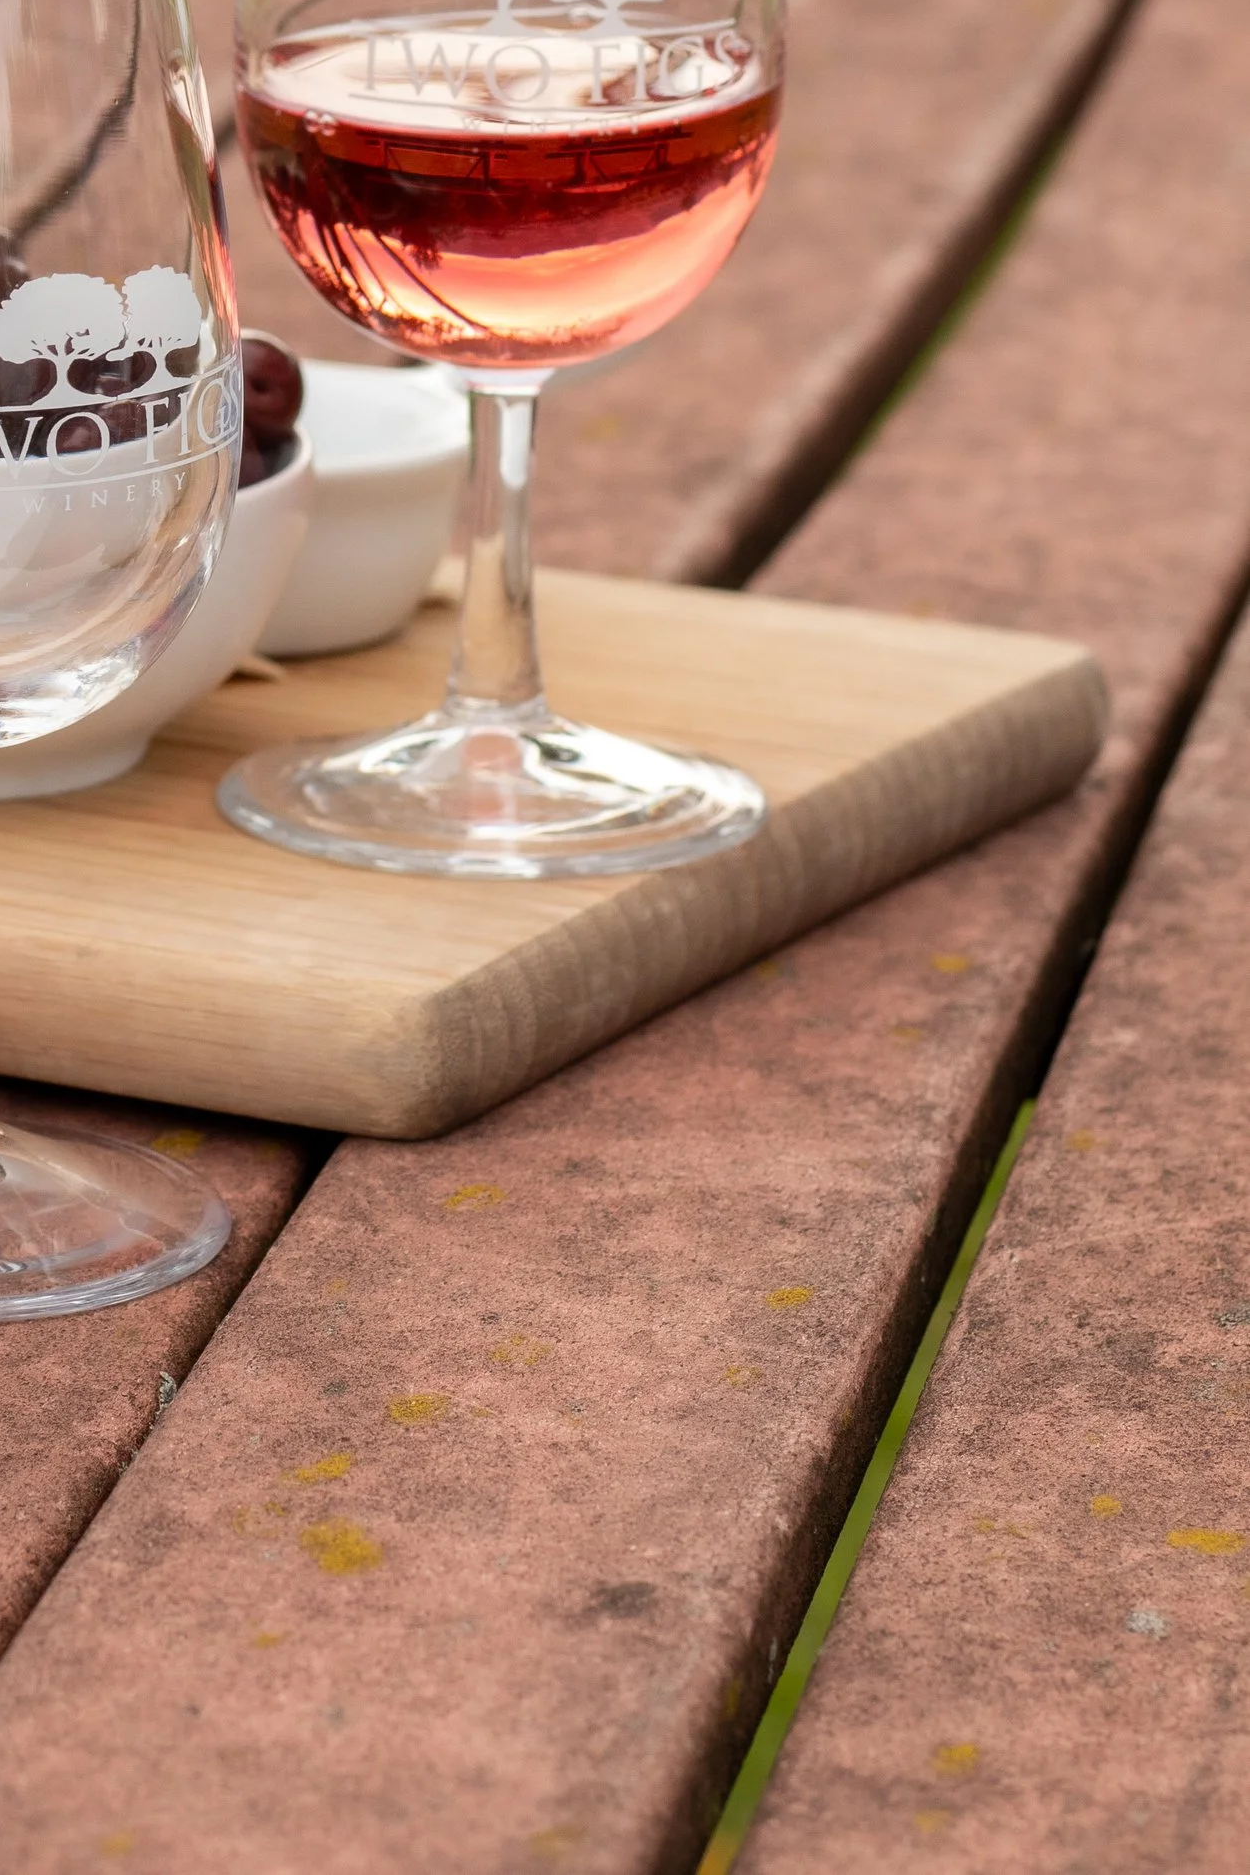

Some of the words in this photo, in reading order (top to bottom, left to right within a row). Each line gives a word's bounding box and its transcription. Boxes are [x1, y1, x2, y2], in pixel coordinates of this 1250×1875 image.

[351, 33, 550, 103] TWO
[590, 30, 739, 105] FIGS
[21, 471, 186, 514] WINERY
